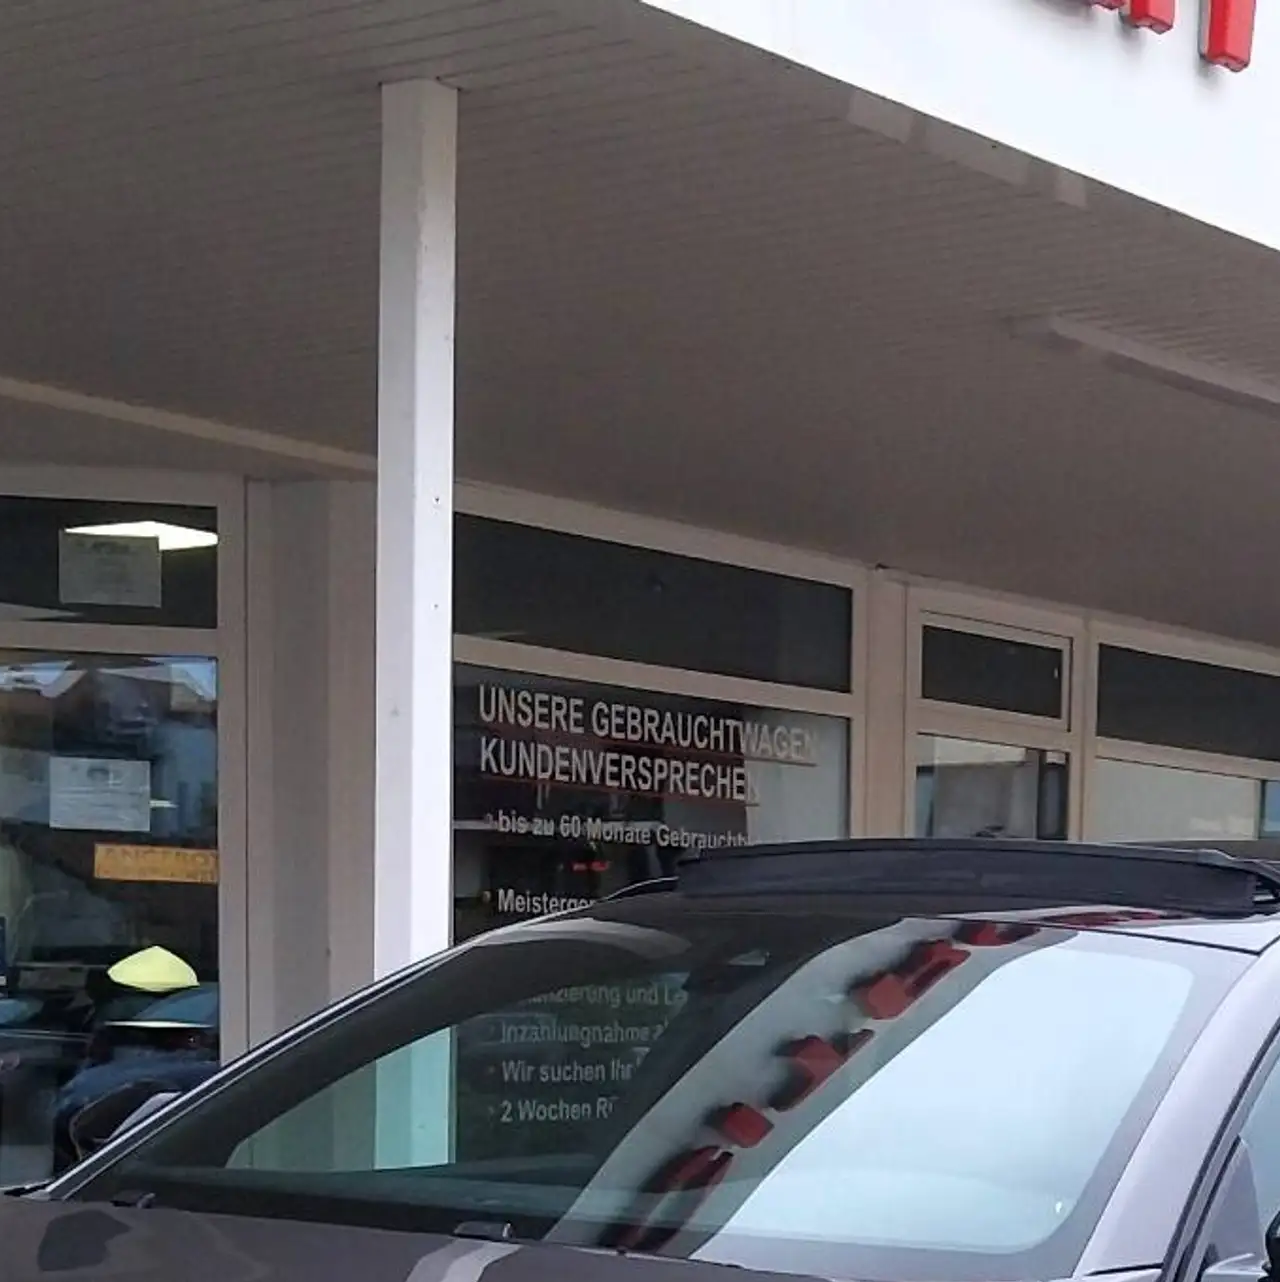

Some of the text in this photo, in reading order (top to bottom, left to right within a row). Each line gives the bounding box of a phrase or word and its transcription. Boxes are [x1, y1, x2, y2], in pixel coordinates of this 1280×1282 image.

[479, 684, 818, 759] UNSERE GEBRAUCHTWAGEN
[498, 810, 528, 834] bis
[532, 818, 555, 836] zu
[560, 815, 582, 838] 60
[586, 817, 652, 845] Monate
[502, 1059, 535, 1082] Wir
[539, 1059, 606, 1083] suchen
[499, 1099, 513, 1122] 2
[517, 1097, 592, 1121] Wochen
